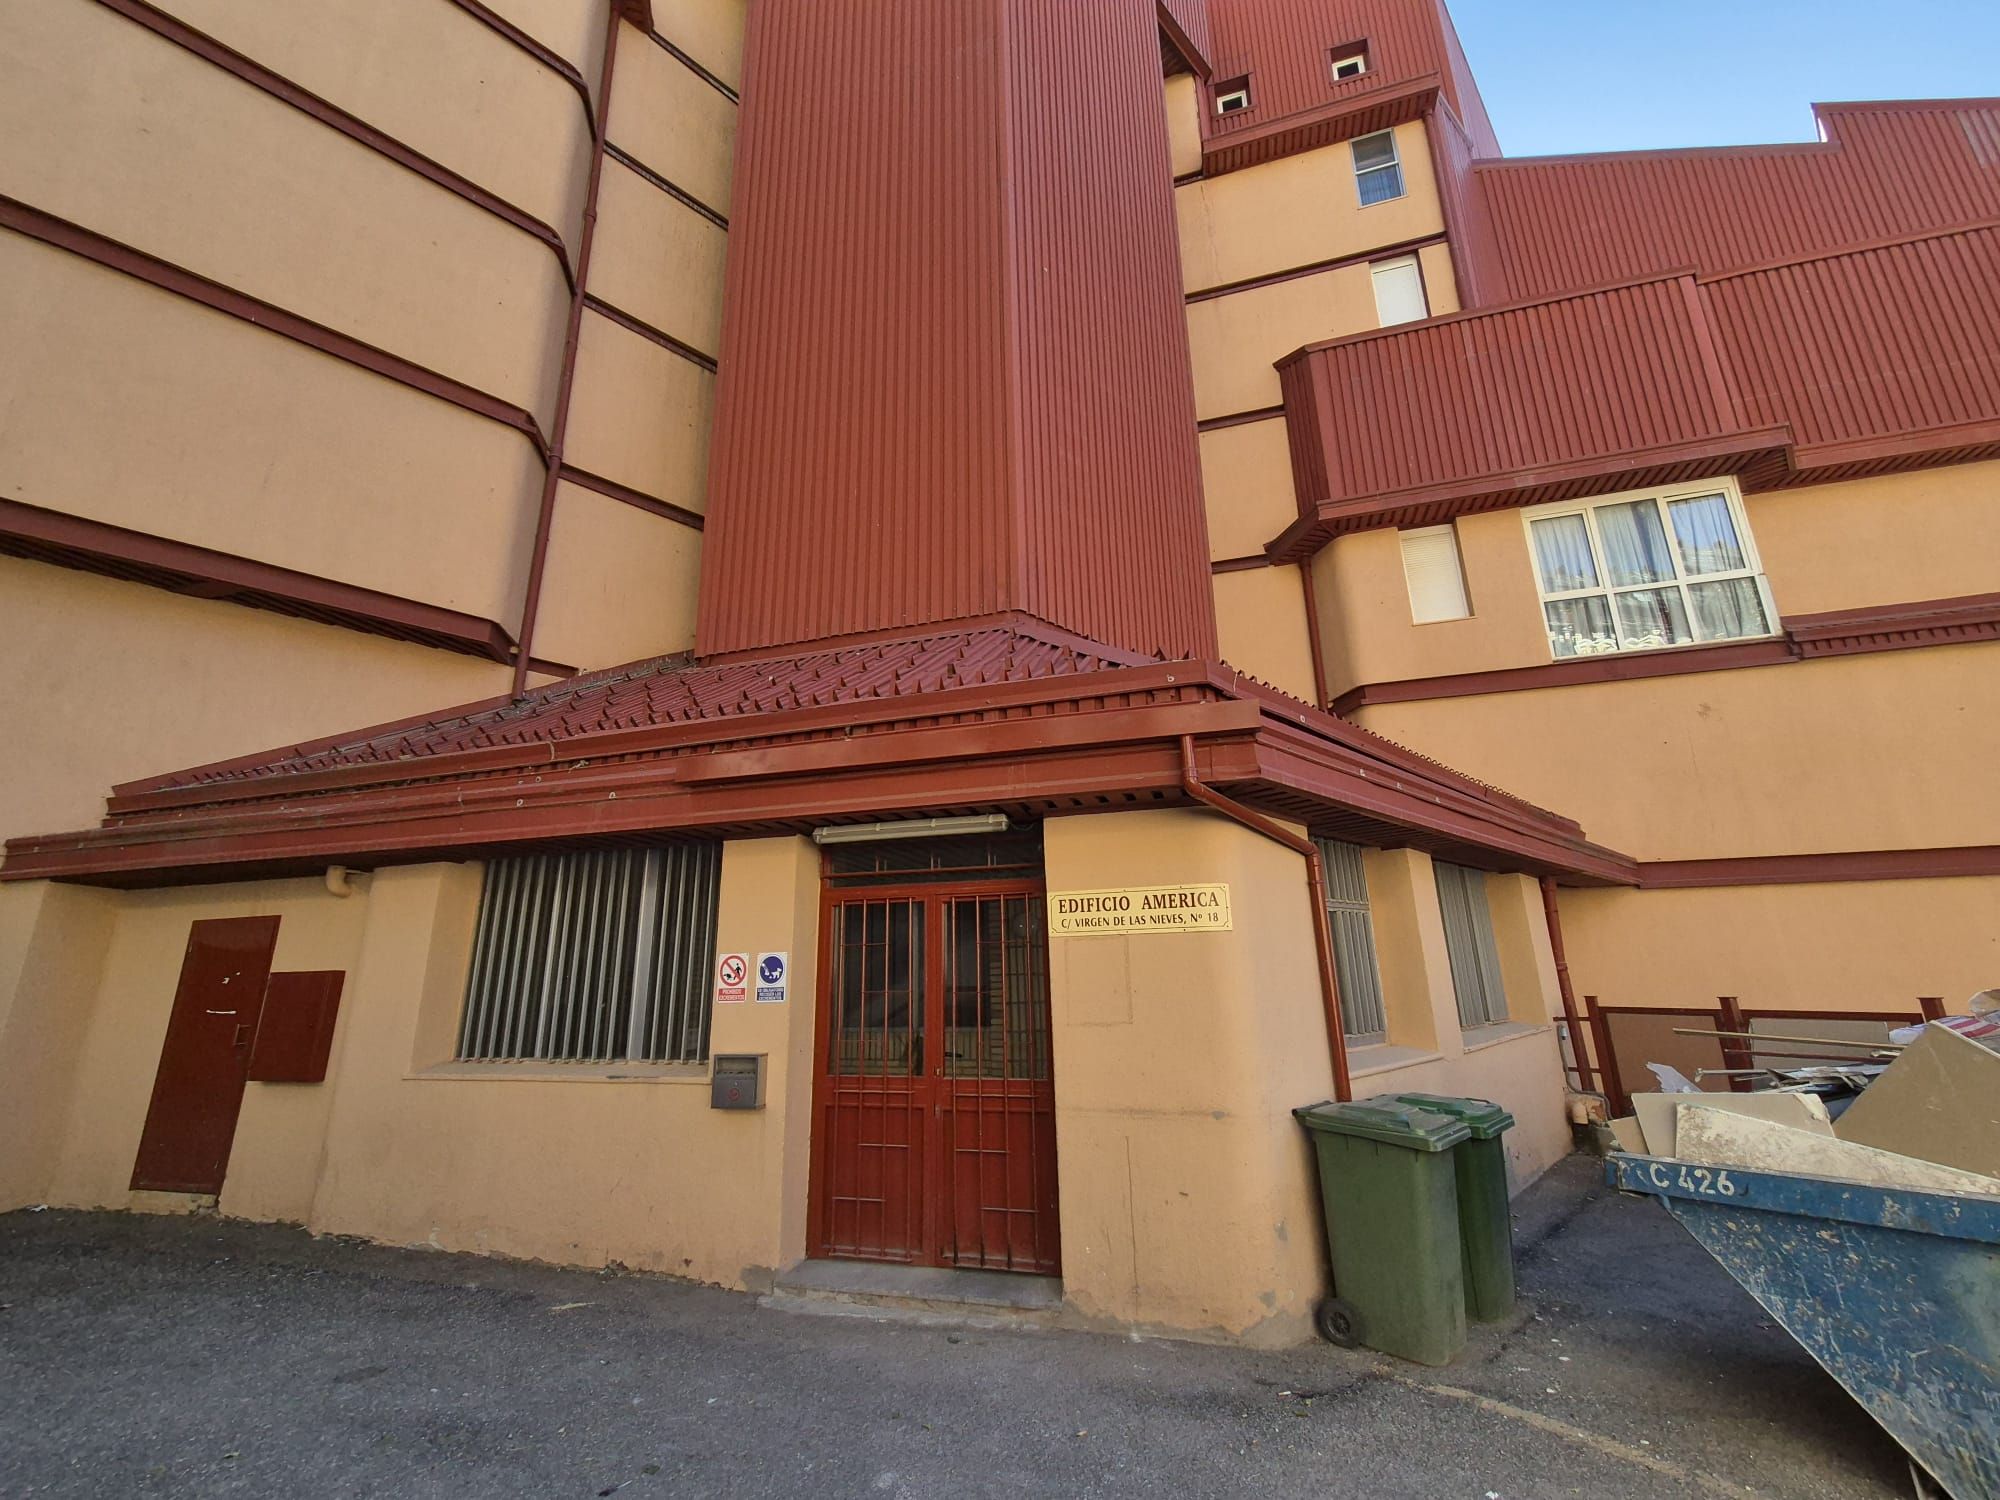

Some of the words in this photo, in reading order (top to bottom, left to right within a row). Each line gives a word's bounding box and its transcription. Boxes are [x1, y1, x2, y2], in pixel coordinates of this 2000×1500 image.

[1058, 896, 1130, 914] EDIFICIO
[1141, 891, 1220, 910] AMERICA
[1061, 918, 1072, 929] C/
[1075, 916, 1110, 928] VIRGEN
[1113, 915, 1127, 926] DE
[1129, 914, 1147, 925] LAS
[1149, 913, 1187, 925] NIEVES,
[1207, 912, 1219, 922] 18
[1650, 1163, 1669, 1188] C
[1677, 1166, 1735, 1196] 426
